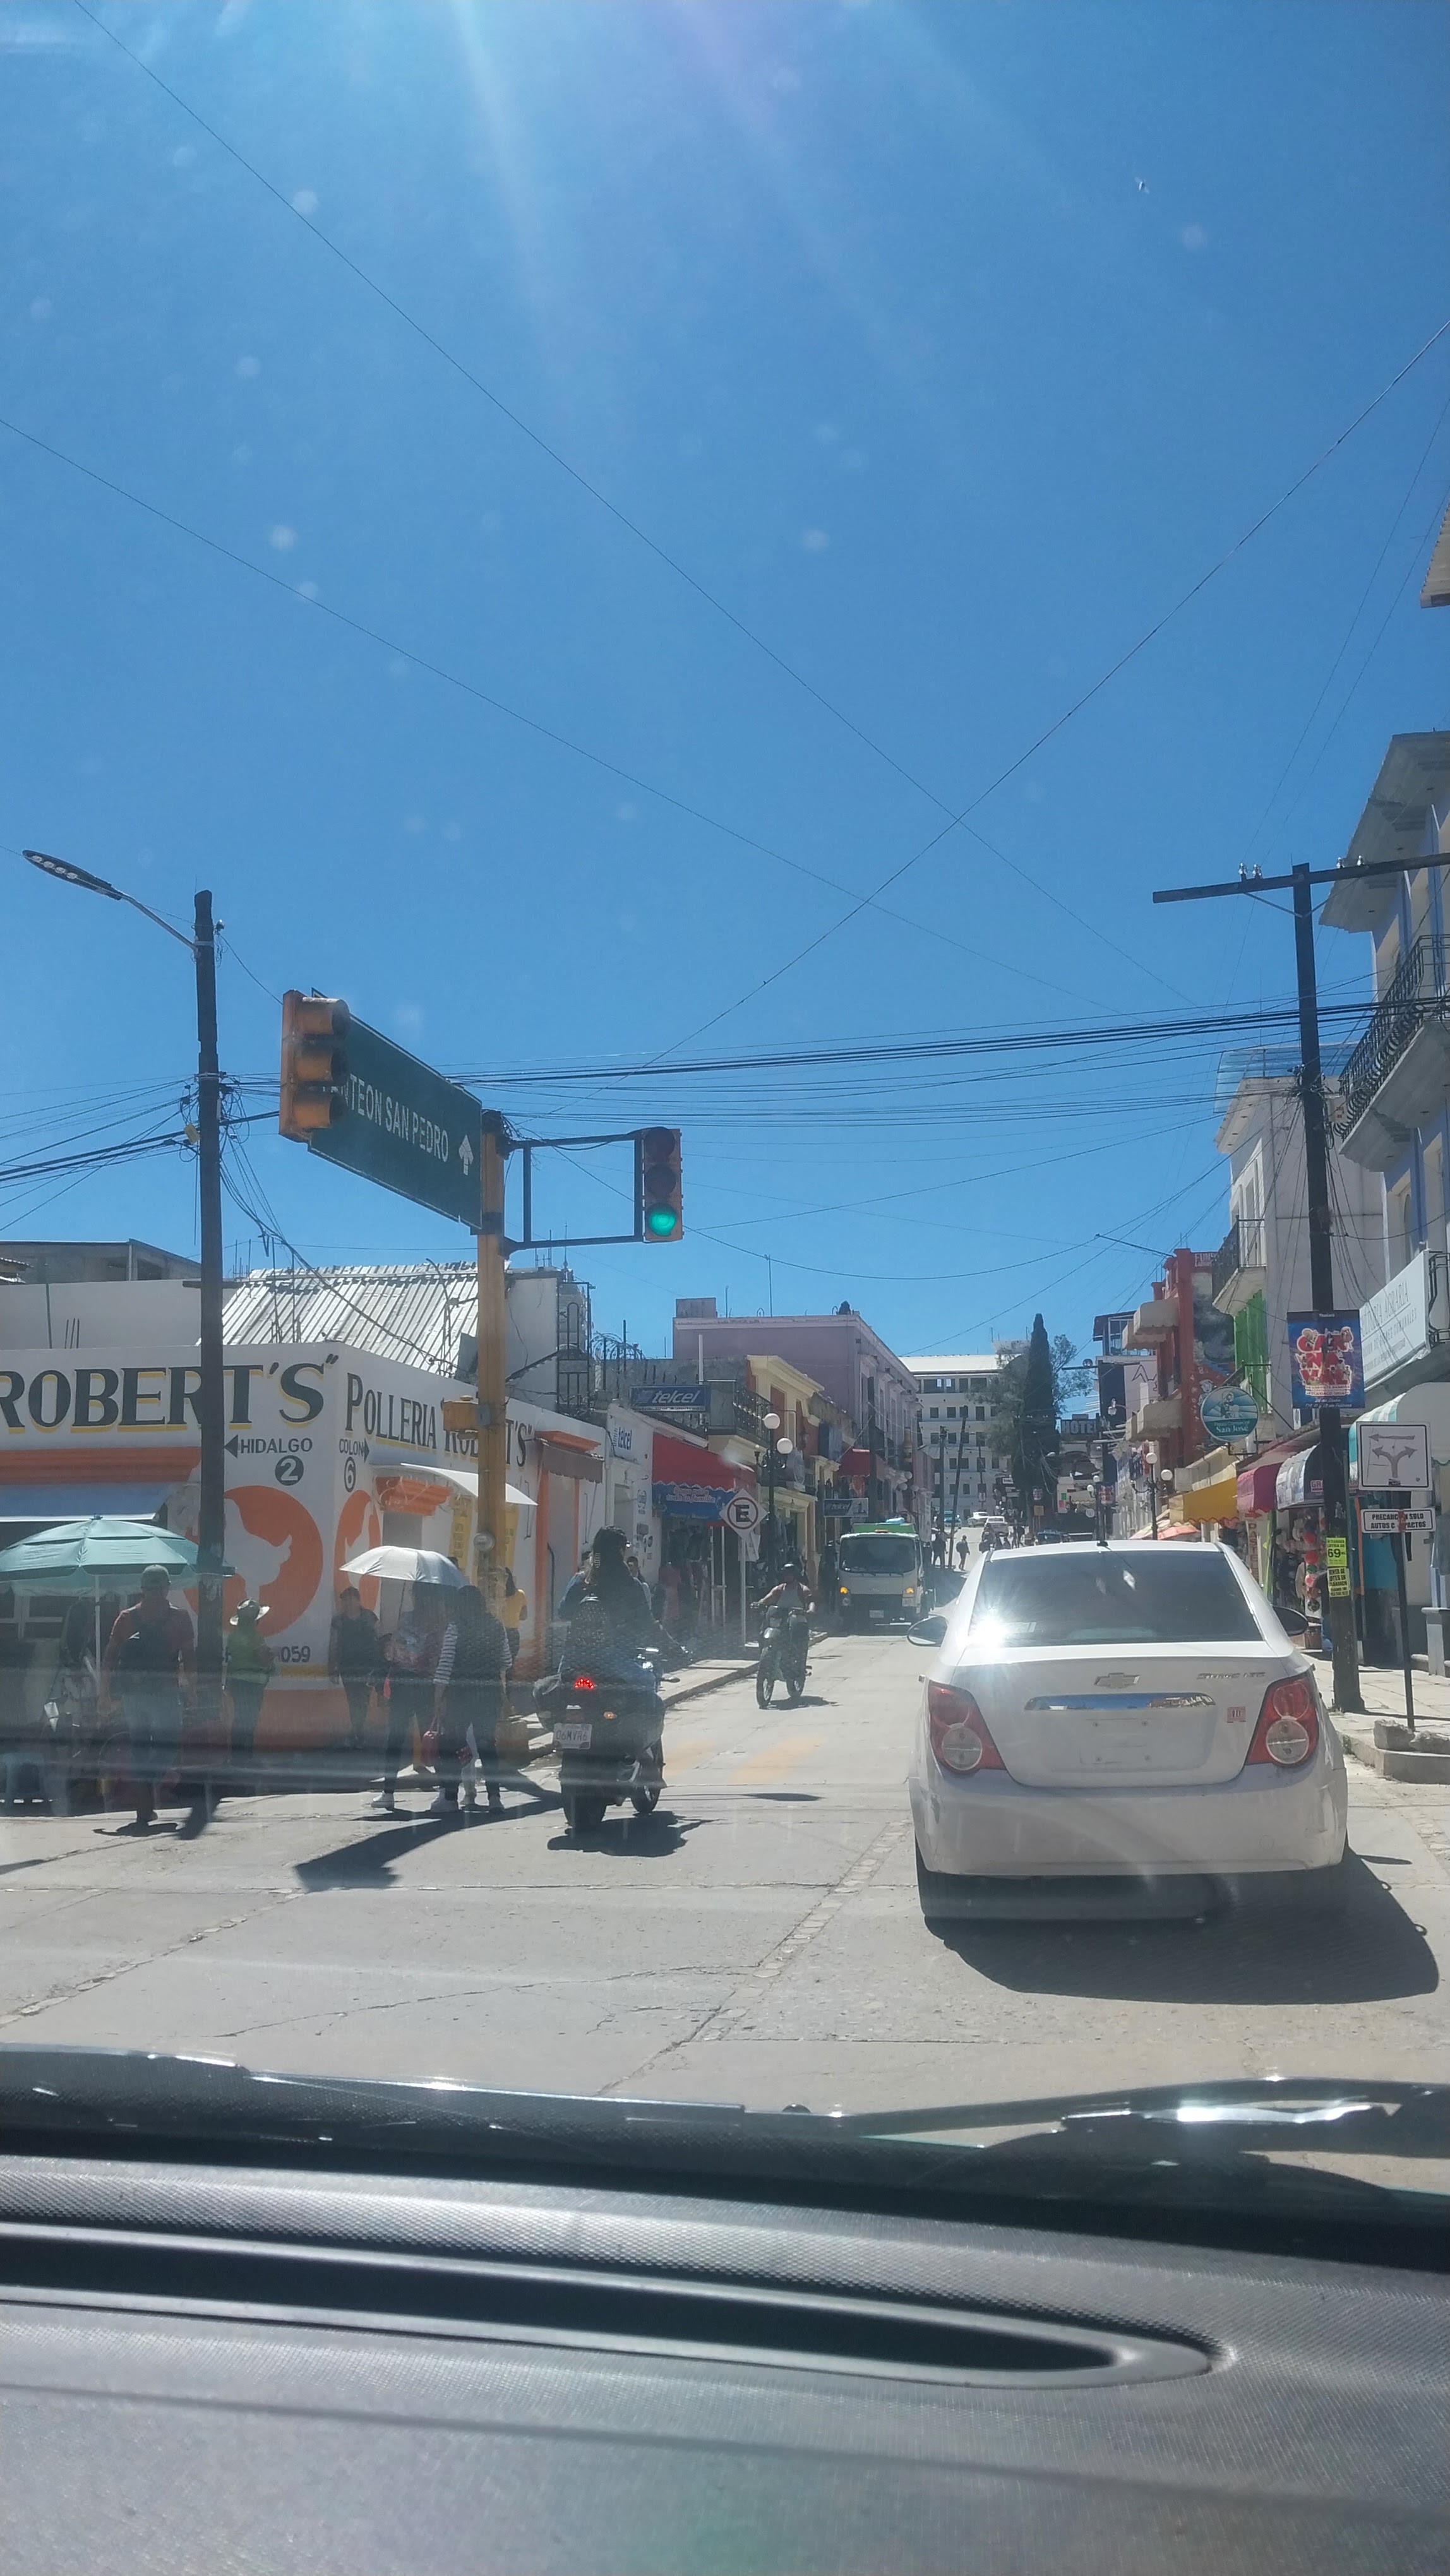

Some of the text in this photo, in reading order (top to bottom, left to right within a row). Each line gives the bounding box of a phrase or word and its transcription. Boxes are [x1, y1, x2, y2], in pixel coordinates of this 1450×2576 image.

[385, 1096, 409, 1141] SAN
[412, 1111, 448, 1162] PEDRO
[652, 1390, 701, 1404] telcel
[345, 1373, 437, 1450] POLLERIA
[241, 1438, 313, 1453] HIDALGO
[339, 1438, 364, 1458] COLON
[618, 1426, 632, 1451] telcel
[280, 1457, 299, 1481] 2
[735, 1504, 750, 1523] E
[1327, 1548, 1341, 1558] 69
